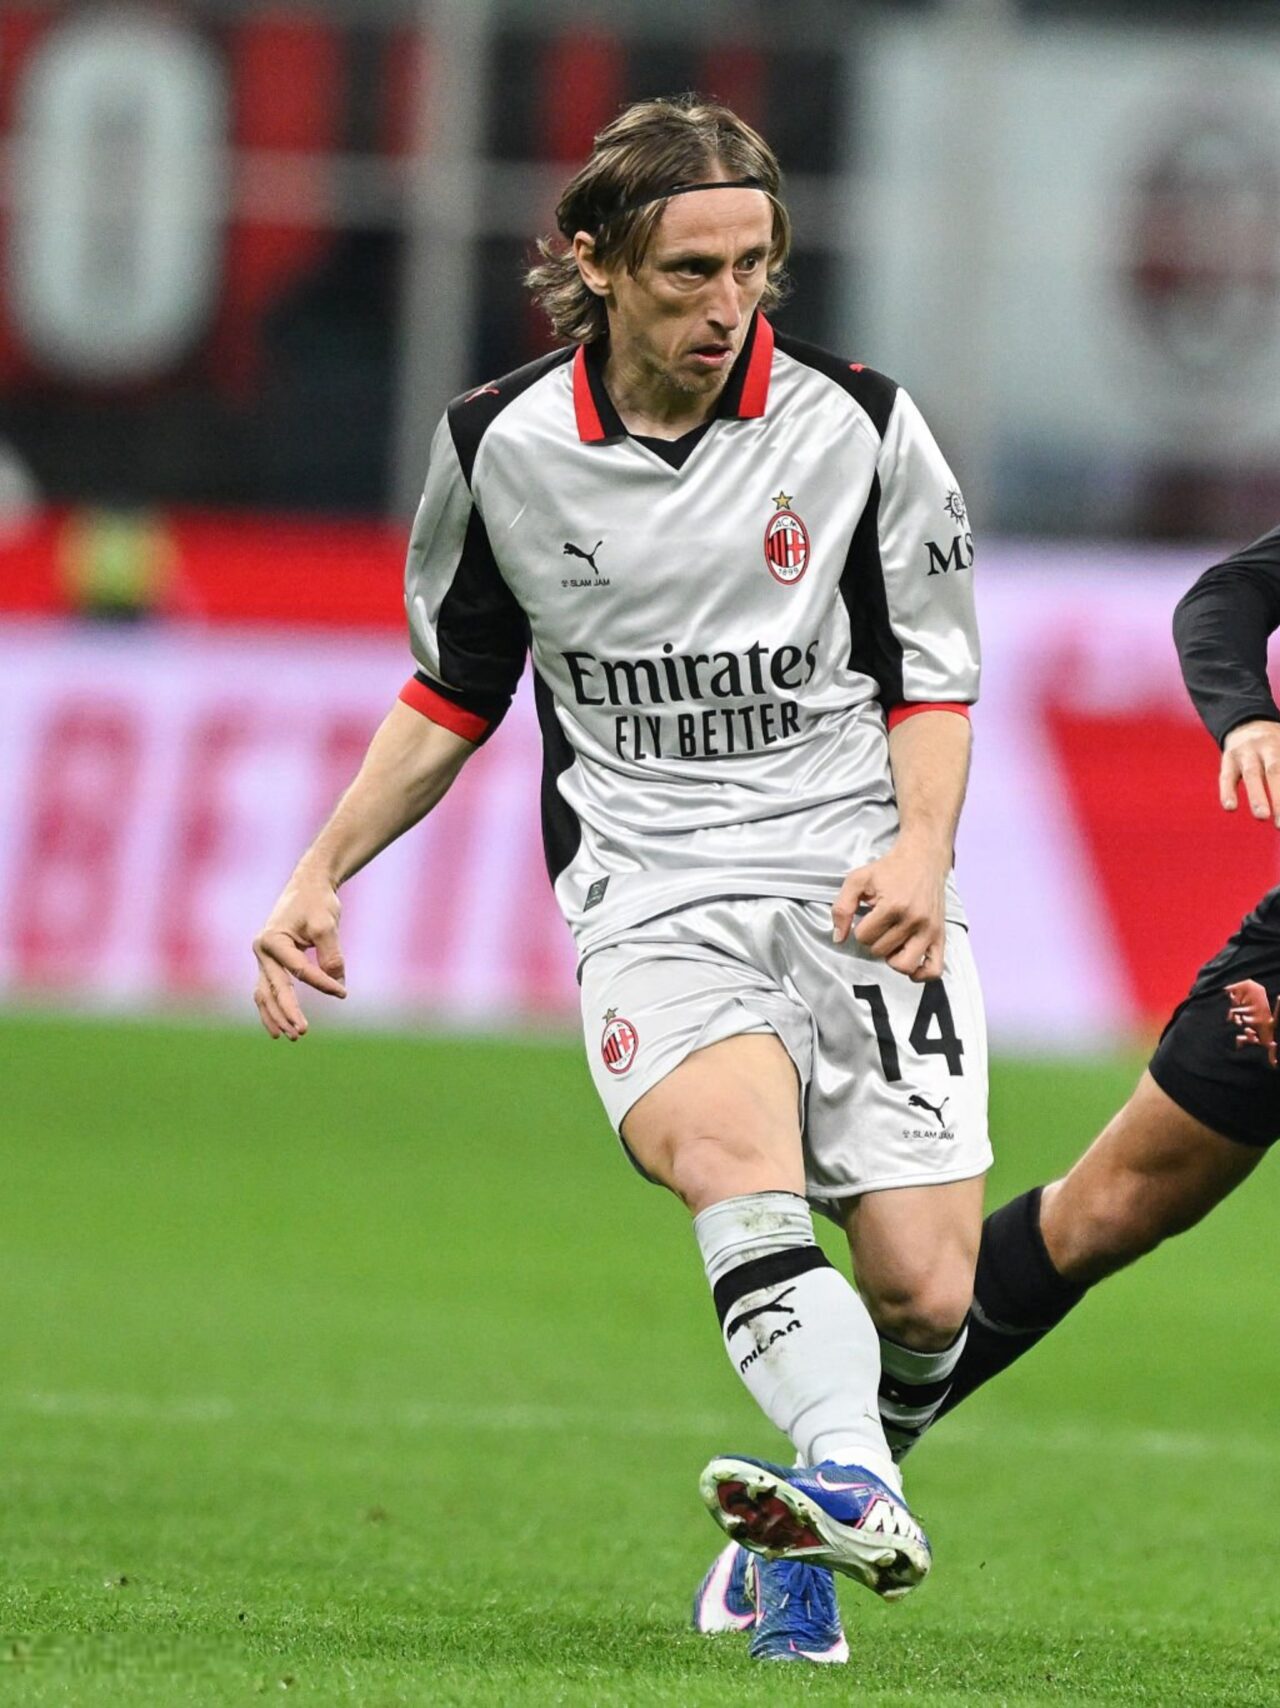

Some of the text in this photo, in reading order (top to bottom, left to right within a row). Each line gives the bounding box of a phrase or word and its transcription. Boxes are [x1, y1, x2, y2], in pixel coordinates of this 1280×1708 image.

[570, 578, 610, 587] SLAM JAM
[561, 640, 819, 706] Emirates
[615, 701, 801, 760] FLY BETTER
[852, 978, 965, 1082] 14
[913, 1130, 955, 1140] SLAM JAM
